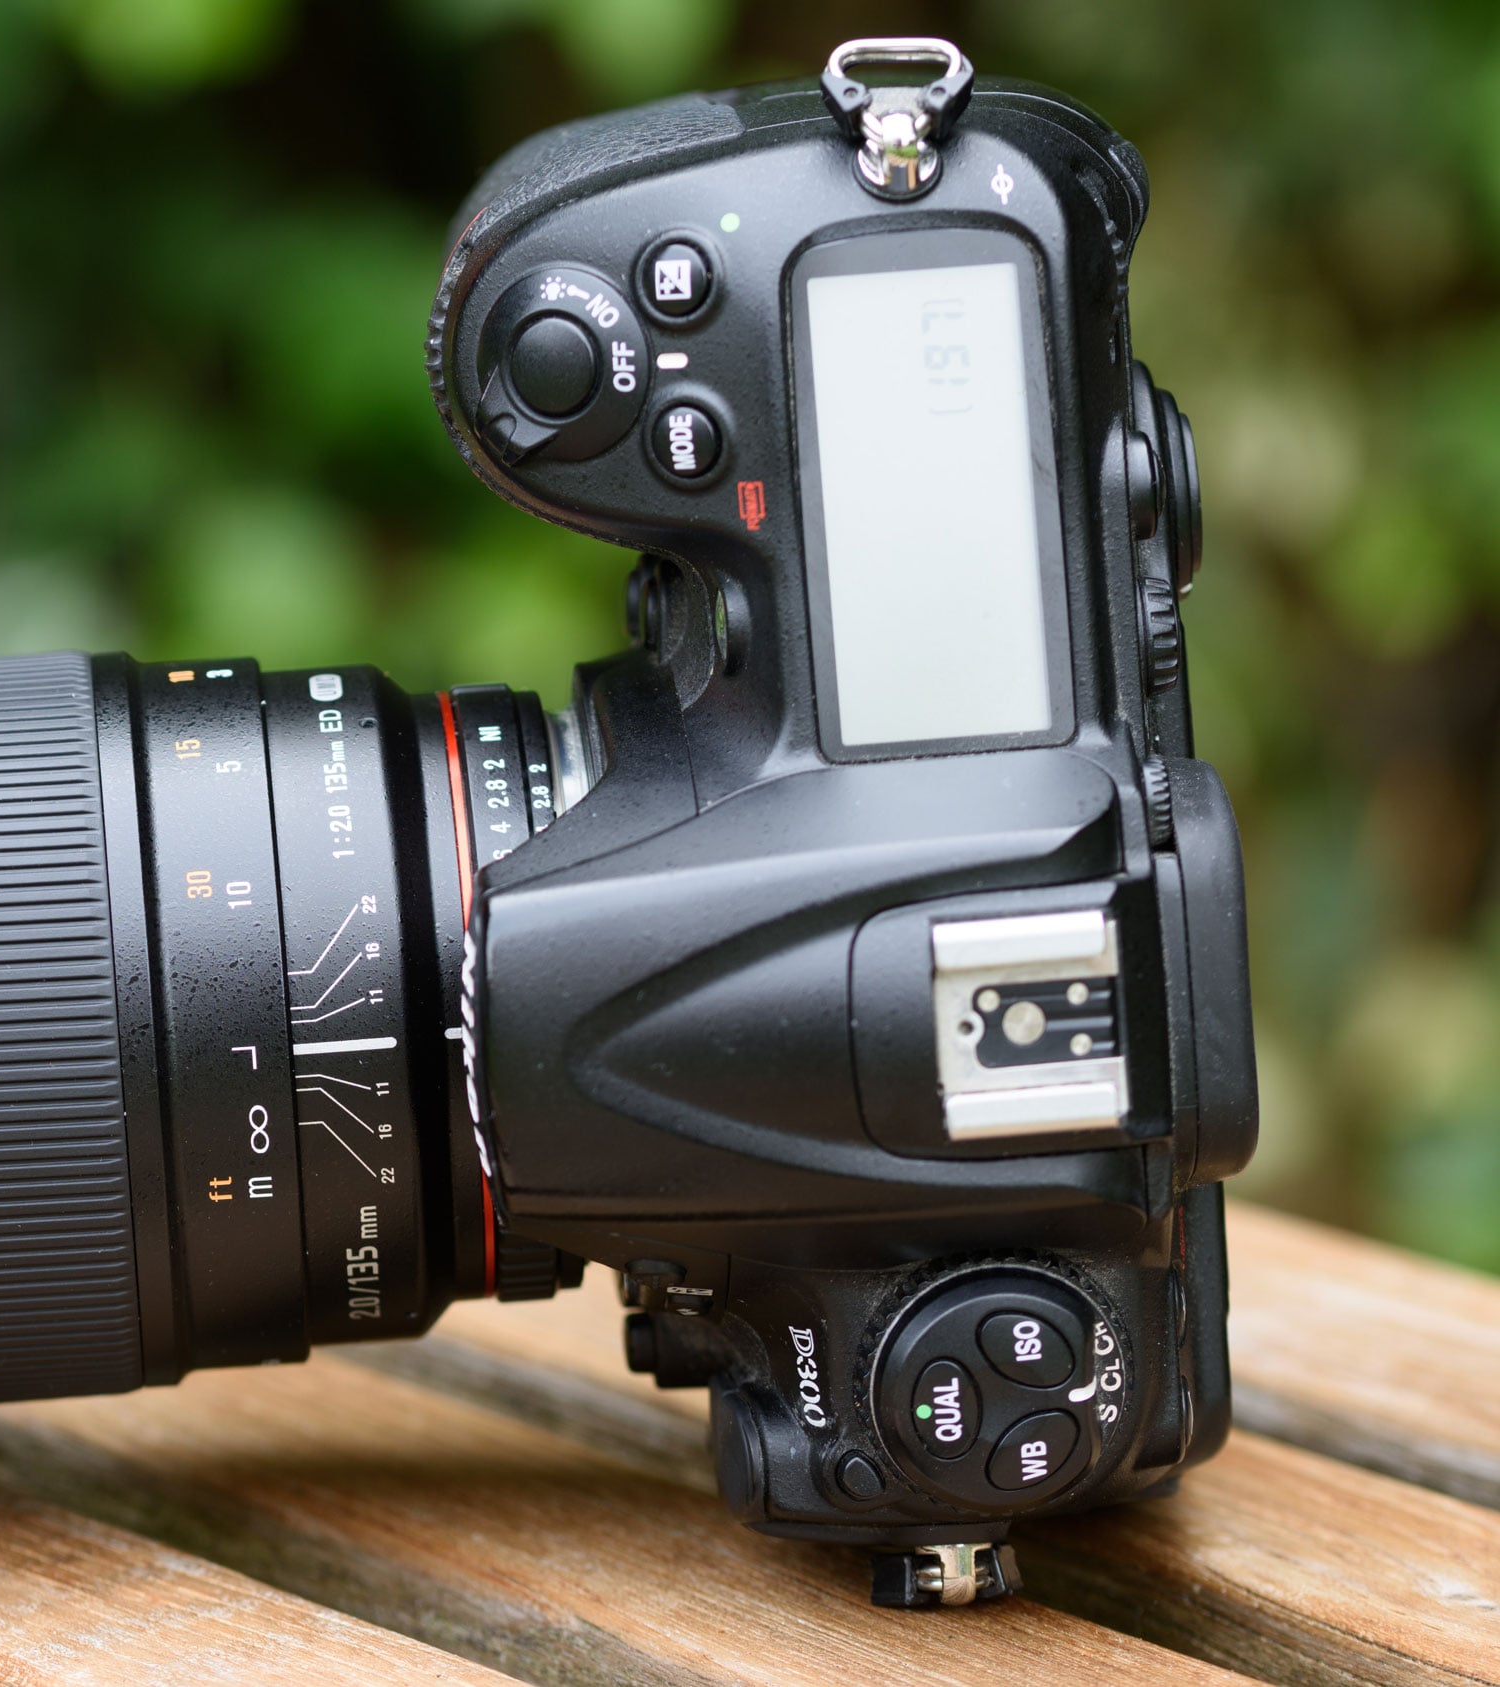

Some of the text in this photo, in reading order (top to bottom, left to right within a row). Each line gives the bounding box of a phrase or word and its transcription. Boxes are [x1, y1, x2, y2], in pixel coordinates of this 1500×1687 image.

[585, 293, 620, 329] ON
[611, 340, 636, 393] OFF
[668, 413, 696, 470] MODE
[205, 668, 234, 679] 3
[318, 709, 344, 734] ED
[478, 726, 502, 742] NI
[174, 738, 202, 762] 15
[215, 760, 242, 774] 5
[482, 758, 506, 770] 2
[528, 763, 547, 773] 2
[484, 779, 510, 810] 2.8
[531, 785, 551, 810] 2.8
[489, 820, 512, 834] 4
[187, 869, 213, 899] 30
[225, 880, 252, 910] 10
[360, 894, 395, 1184] 22 16 11 11 16 22
[208, 1176, 233, 1203] ft
[248, 1176, 273, 1199] m
[1013, 1320, 1042, 1362] ISO
[788, 1325, 827, 1428] D300
[932, 1377, 963, 1442] QUAL
[1098, 1403, 1118, 1423] S
[1020, 1440, 1048, 1481] WB
